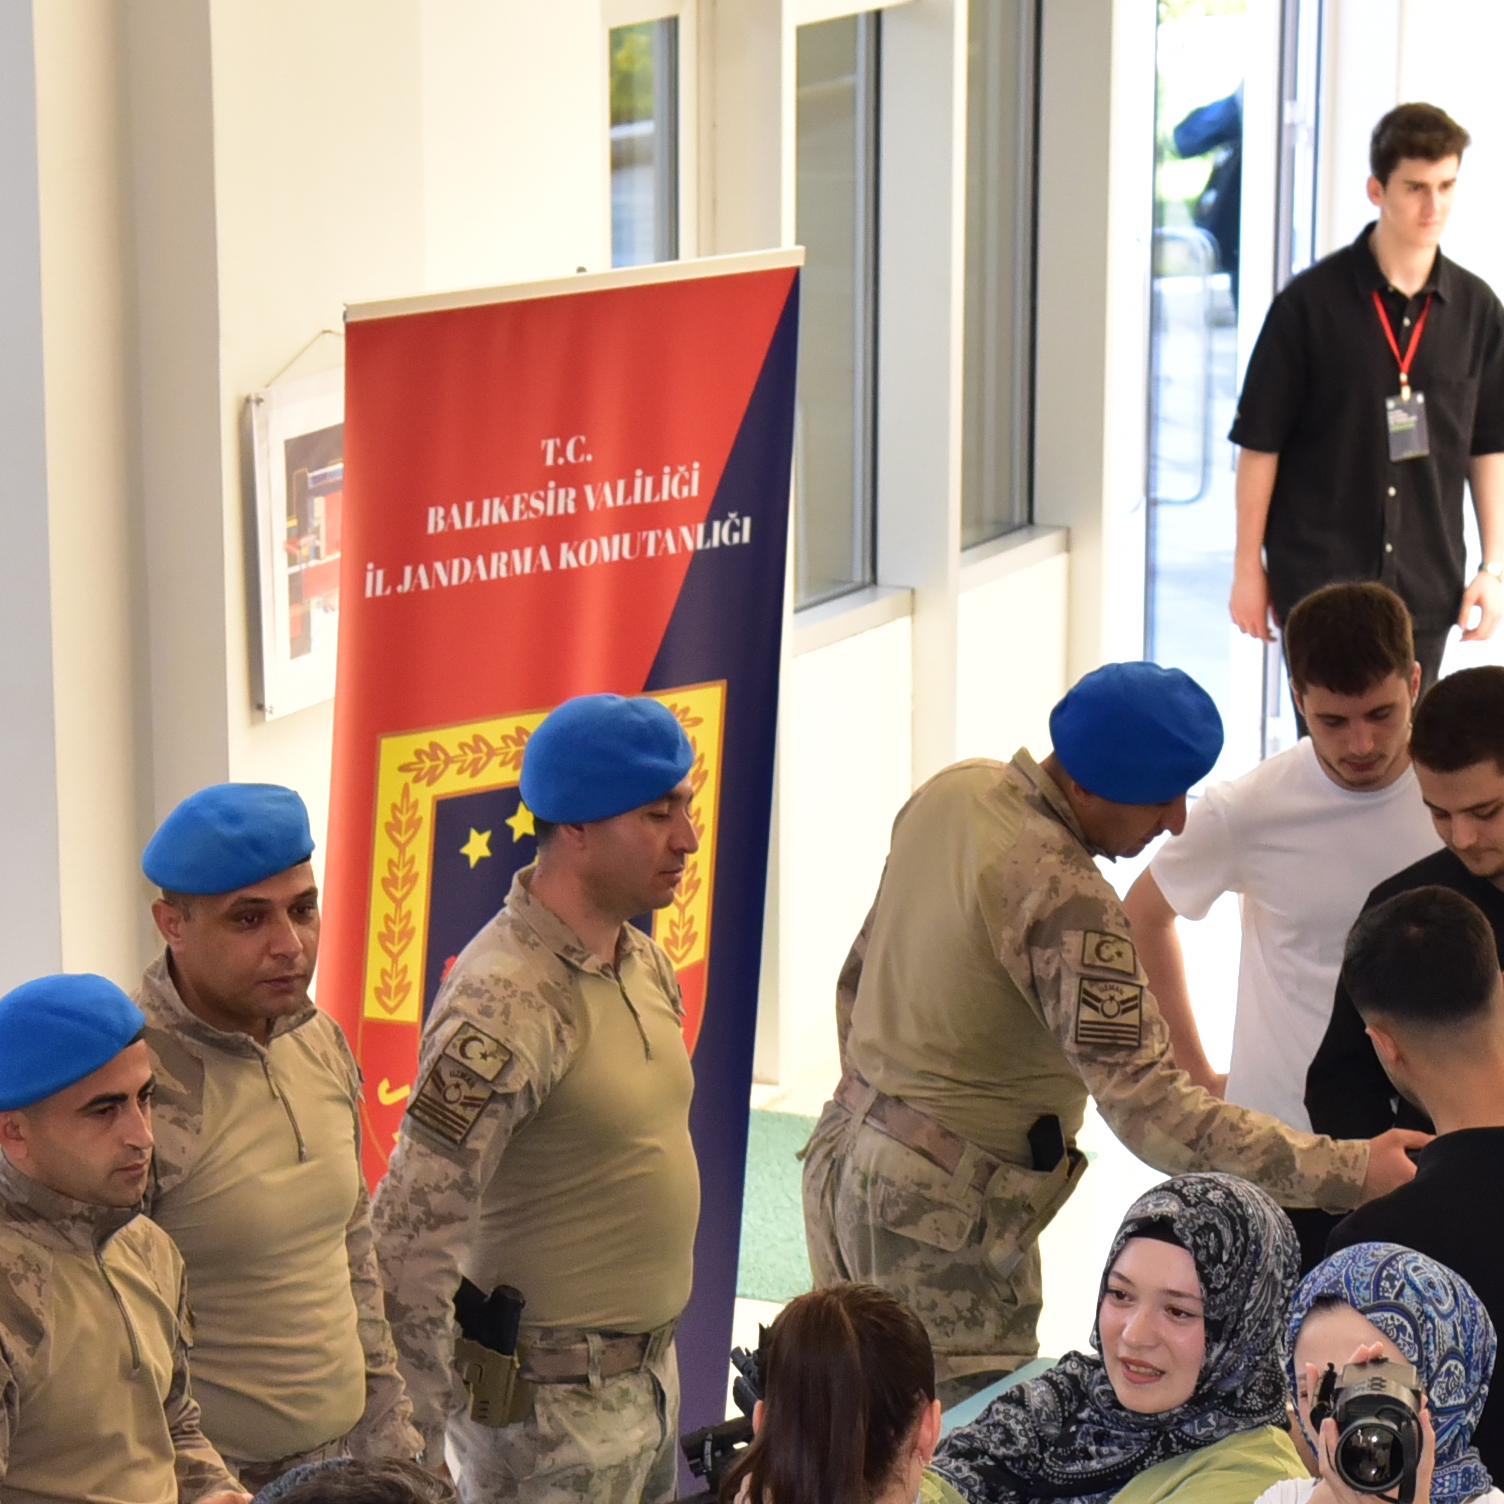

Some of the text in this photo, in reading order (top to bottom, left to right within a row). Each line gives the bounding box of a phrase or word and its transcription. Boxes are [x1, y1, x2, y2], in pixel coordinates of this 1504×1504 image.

[540, 435, 594, 468] T.C.
[426, 461, 701, 536] BALIKESİR VALİLİĞİ
[364, 511, 753, 599] İL JANDARMA KOMUTANLIĞI
